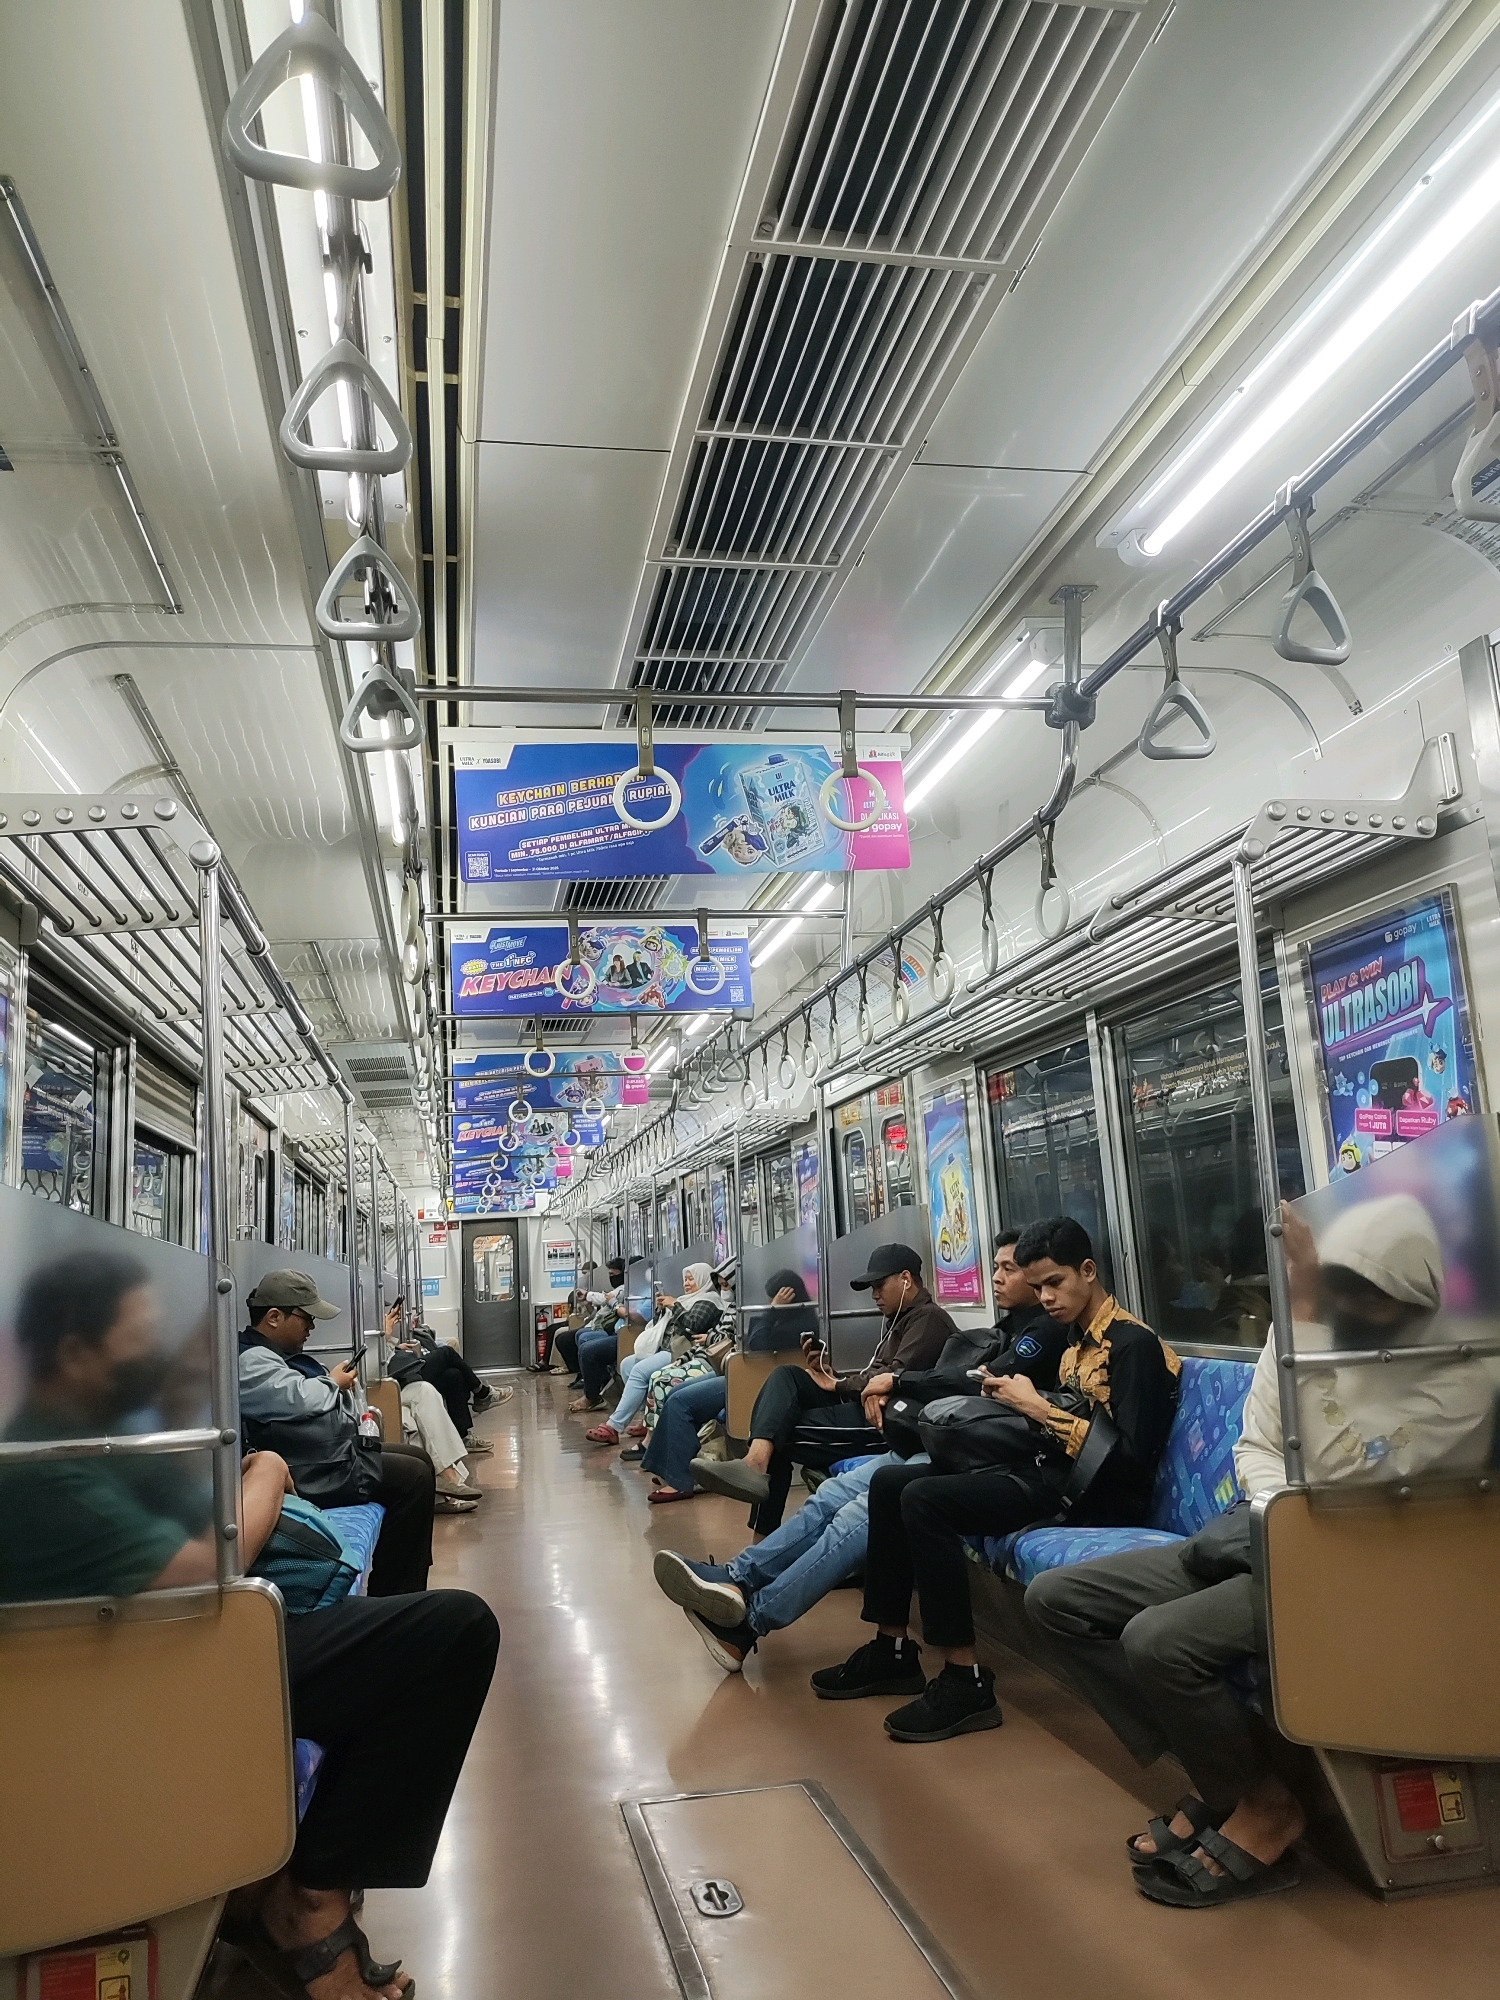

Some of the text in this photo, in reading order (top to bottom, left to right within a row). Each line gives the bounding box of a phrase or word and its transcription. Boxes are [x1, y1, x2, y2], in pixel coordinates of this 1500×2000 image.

[570, 774, 644, 792] BERHADH
[768, 780, 796, 796] ULTRA
[499, 784, 565, 806] KEYCHAIN
[774, 789, 795, 803] MILK
[470, 809, 526, 829] KUNCIAN
[531, 803, 564, 818] PARA
[568, 792, 624, 812] PEJUAN
[872, 823, 902, 832] gopay
[522, 838, 548, 848] SETIAP
[551, 830, 593, 843] PEMBELIAN
[595, 824, 620, 834] ULTRA
[511, 850, 528, 859] MIN.
[530, 845, 557, 855] 75.000
[1394, 923, 1417, 940] gopay
[515, 958, 532, 966] NFC
[1321, 956, 1382, 1003] PLAY & WIN
[1322, 960, 1419, 1047] ULTRASOBI
[1372, 1122, 1387, 1130] JUTA
[1421, 1117, 1436, 1125] Ruby
